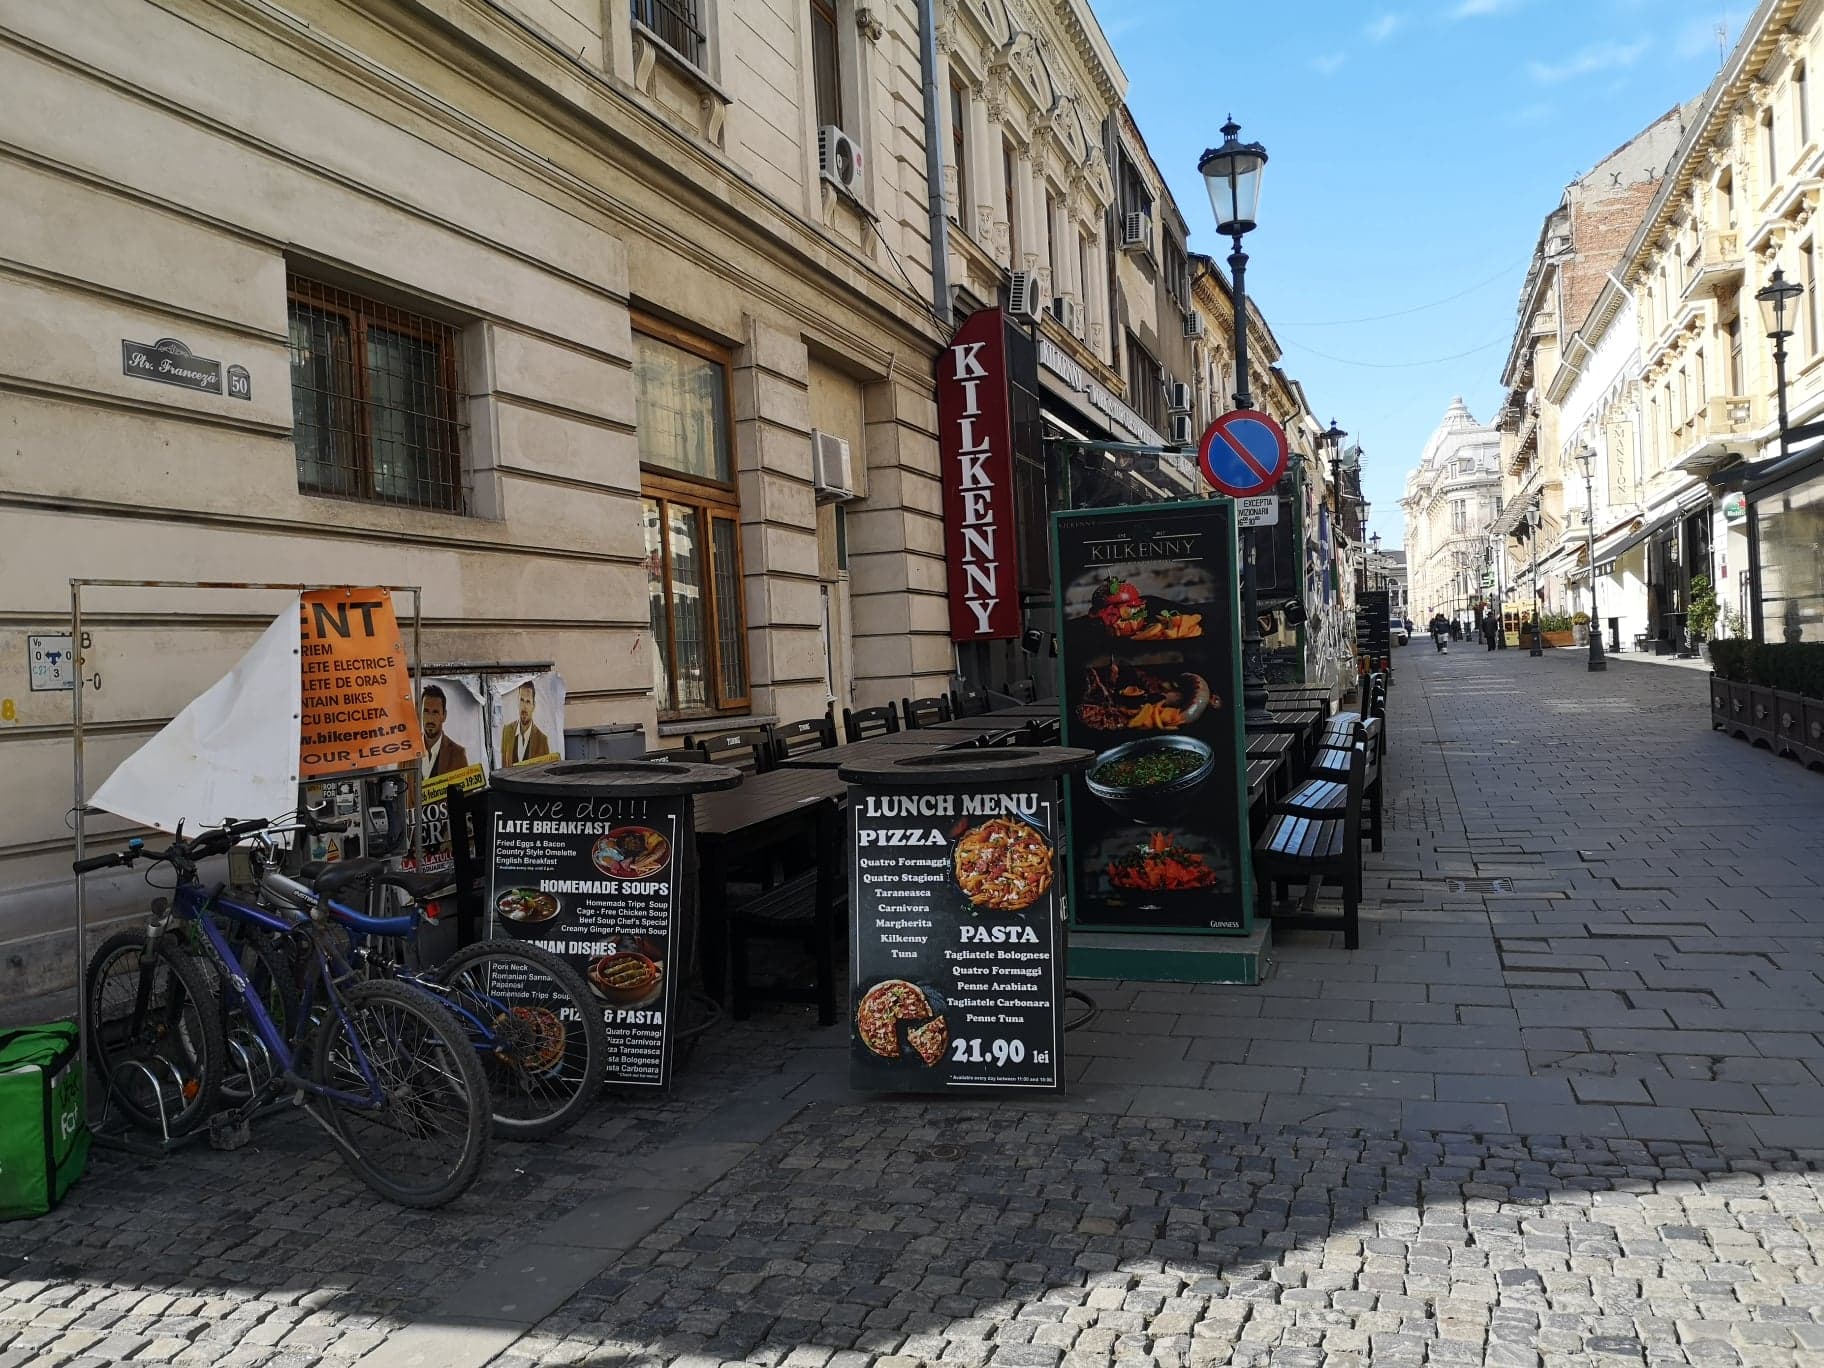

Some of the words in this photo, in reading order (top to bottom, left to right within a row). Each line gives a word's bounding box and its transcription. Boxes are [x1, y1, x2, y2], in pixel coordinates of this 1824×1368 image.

[232, 376, 248, 394] 50
[950, 342, 1000, 634] KILKENNY
[1092, 540, 1195, 560] KILKENNY
[334, 656, 394, 672] ELECTRICE
[54, 668, 60, 678] 3
[302, 678, 330, 691] LETE
[336, 676, 352, 688] DE
[355, 674, 387, 688] ORAS
[344, 692, 374, 705] BIKES
[302, 713, 321, 726] CU
[324, 708, 388, 724] BICICLETA
[301, 750, 350, 764] OUR
[358, 740, 412, 758] LEGS
[524, 800, 564, 818] we
[866, 795, 955, 817] LUNCH
[961, 793, 1038, 816] MENU
[498, 820, 530, 834] LATE
[533, 820, 612, 834] BREAKFAST
[859, 828, 947, 846] PIZZA
[516, 840, 534, 849] Eggs
[536, 840, 542, 848] &
[543, 840, 566, 848] Bacon
[496, 848, 524, 857] Country
[526, 848, 544, 857] Style
[545, 849, 577, 857] Omelette
[496, 857, 522, 866] English
[524, 857, 558, 865] Breakfast
[860, 858, 896, 868] Quatro
[899, 858, 950, 868] Formaggi
[864, 874, 898, 883] Quatro
[902, 873, 944, 883] Stagioni
[540, 880, 619, 894] HOMEMADE
[621, 880, 669, 896] SOUPS
[875, 888, 931, 897] Taraneasca
[586, 900, 626, 908] Homemade
[627, 900, 646, 909] Tripe
[649, 900, 668, 910] Soup
[878, 904, 930, 912] Carnivora
[576, 908, 596, 916] Cage
[601, 908, 617, 916] Free
[618, 909, 648, 917] Chicken
[649, 910, 668, 918] Soup
[580, 916, 596, 924] Beef
[597, 917, 616, 926] Soup
[642, 918, 668, 927] Special
[875, 919, 932, 929] Margherita
[561, 925, 588, 934] Creamy
[590, 926, 614, 935] Ginger
[615, 926, 646, 935] Pumpkin
[648, 928, 667, 936] Soup
[960, 926, 1040, 943] PASTA
[880, 934, 928, 945] Kilkenny
[568, 941, 617, 956] DISHES
[891, 950, 918, 958] Tuna
[944, 950, 995, 960] Tagliatele
[997, 951, 1050, 961] Bolognese
[510, 963, 529, 971] Neck
[952, 966, 990, 976] Quatro
[992, 966, 1042, 977] Formaggi
[957, 982, 988, 991] Penne
[991, 982, 1038, 991] Arabiata
[531, 991, 549, 1000] Tripe
[946, 998, 995, 1008] Tagliatele
[997, 998, 1050, 1008] Carbonara
[560, 1007, 582, 1022] PIZ
[604, 1009, 614, 1023] &
[616, 1010, 662, 1025] PASTA
[966, 1014, 996, 1023] Penne
[998, 1014, 1024, 1023] Tuna
[605, 1028, 630, 1036] Quatro
[632, 1028, 662, 1038] Formagi
[626, 1038, 661, 1046] Carnivora
[620, 1046, 660, 1055] Taraneasca
[951, 1038, 1025, 1067] 21.90
[1033, 1050, 1050, 1064] lei
[621, 1056, 660, 1065] Bolognese
[621, 1065, 659, 1074] Carbonara
